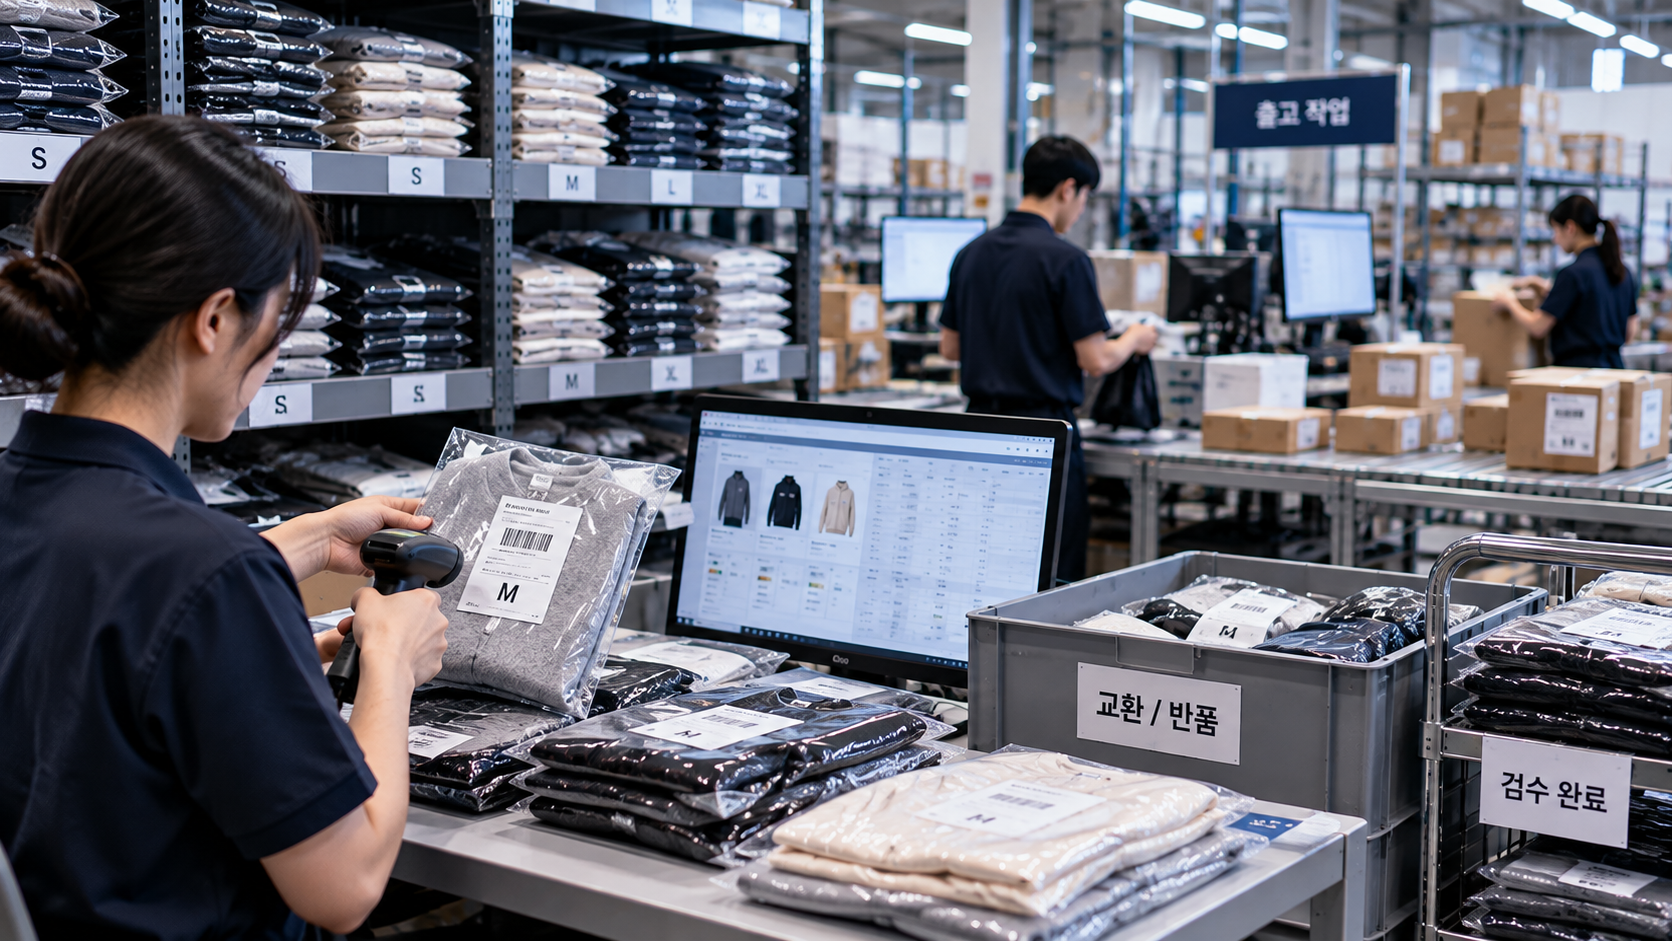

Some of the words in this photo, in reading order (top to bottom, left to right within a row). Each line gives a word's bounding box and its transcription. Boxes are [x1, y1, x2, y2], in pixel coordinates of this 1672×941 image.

[1254, 99, 1301, 129] 출고
[1304, 97, 1350, 127] 작업
[31, 146, 47, 170] S
[274, 160, 287, 180] S
[411, 167, 422, 185] S
[566, 175, 579, 192] M
[668, 179, 676, 196] L
[566, 373, 579, 391] M
[413, 384, 425, 403] S
[275, 394, 288, 414] S
[497, 582, 520, 603] M
[1219, 625, 1238, 639] M
[1096, 691, 1144, 725] 교환
[1150, 699, 1162, 726] /
[1169, 701, 1218, 737] 반품
[1501, 771, 1549, 804] 검수
[1557, 781, 1607, 813] 완료
